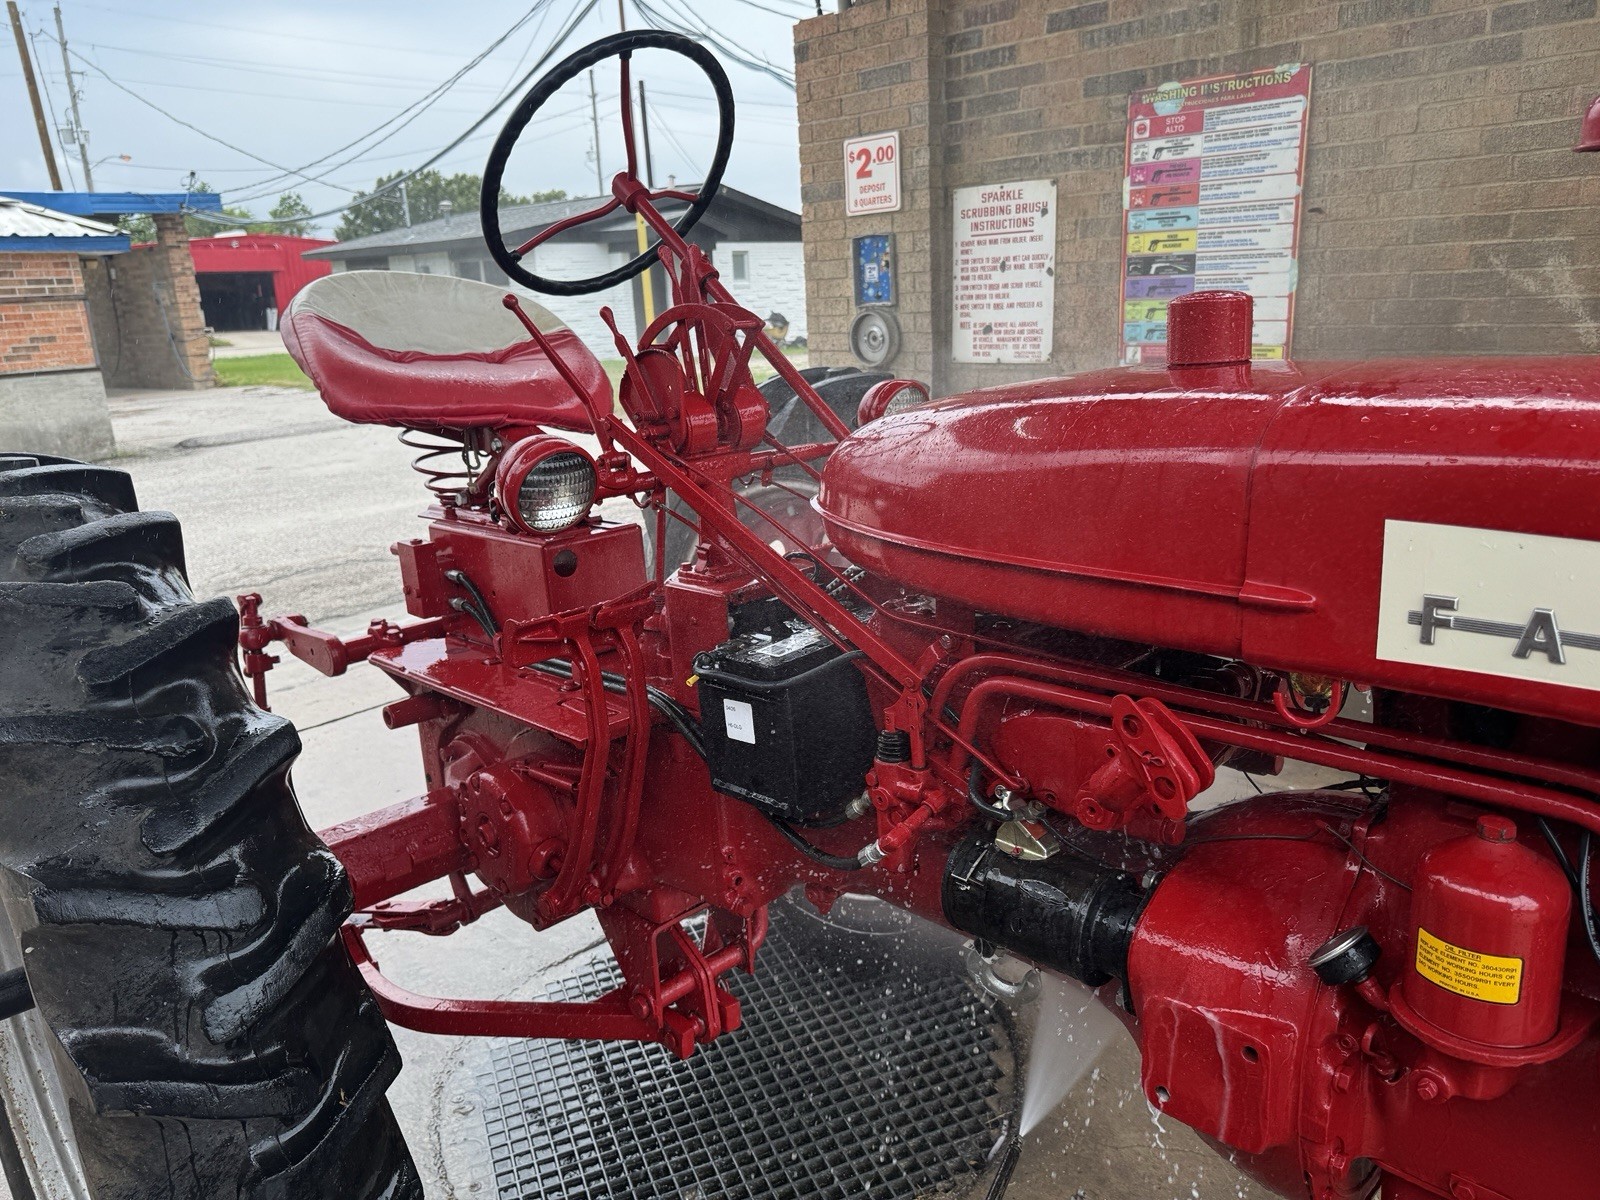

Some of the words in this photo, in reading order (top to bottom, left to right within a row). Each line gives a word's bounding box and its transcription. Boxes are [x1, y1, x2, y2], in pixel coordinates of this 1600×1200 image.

[1201, 72, 1291, 96] INSTRUCTIONS
[1166, 116, 1186, 125] STOP
[860, 183, 885, 194] DEPOSIT
[859, 195, 892, 207] QUARTERS
[981, 189, 1023, 203] SPARKLE
[961, 205, 1012, 219] SCRUBBING
[970, 217, 1034, 232] INSTRUCTIONS
[1440, 950, 1466, 964] ELEMENT
[1445, 944, 1454, 952] OIL
[1458, 949, 1481, 960] FILTER
[1420, 952, 1439, 968] ELEMENT
[1427, 963, 1452, 981] WORKING
[1455, 978, 1479, 989] HOURS.
[1447, 961, 1476, 975] WORKING
[1479, 971, 1503, 979] HOURS
